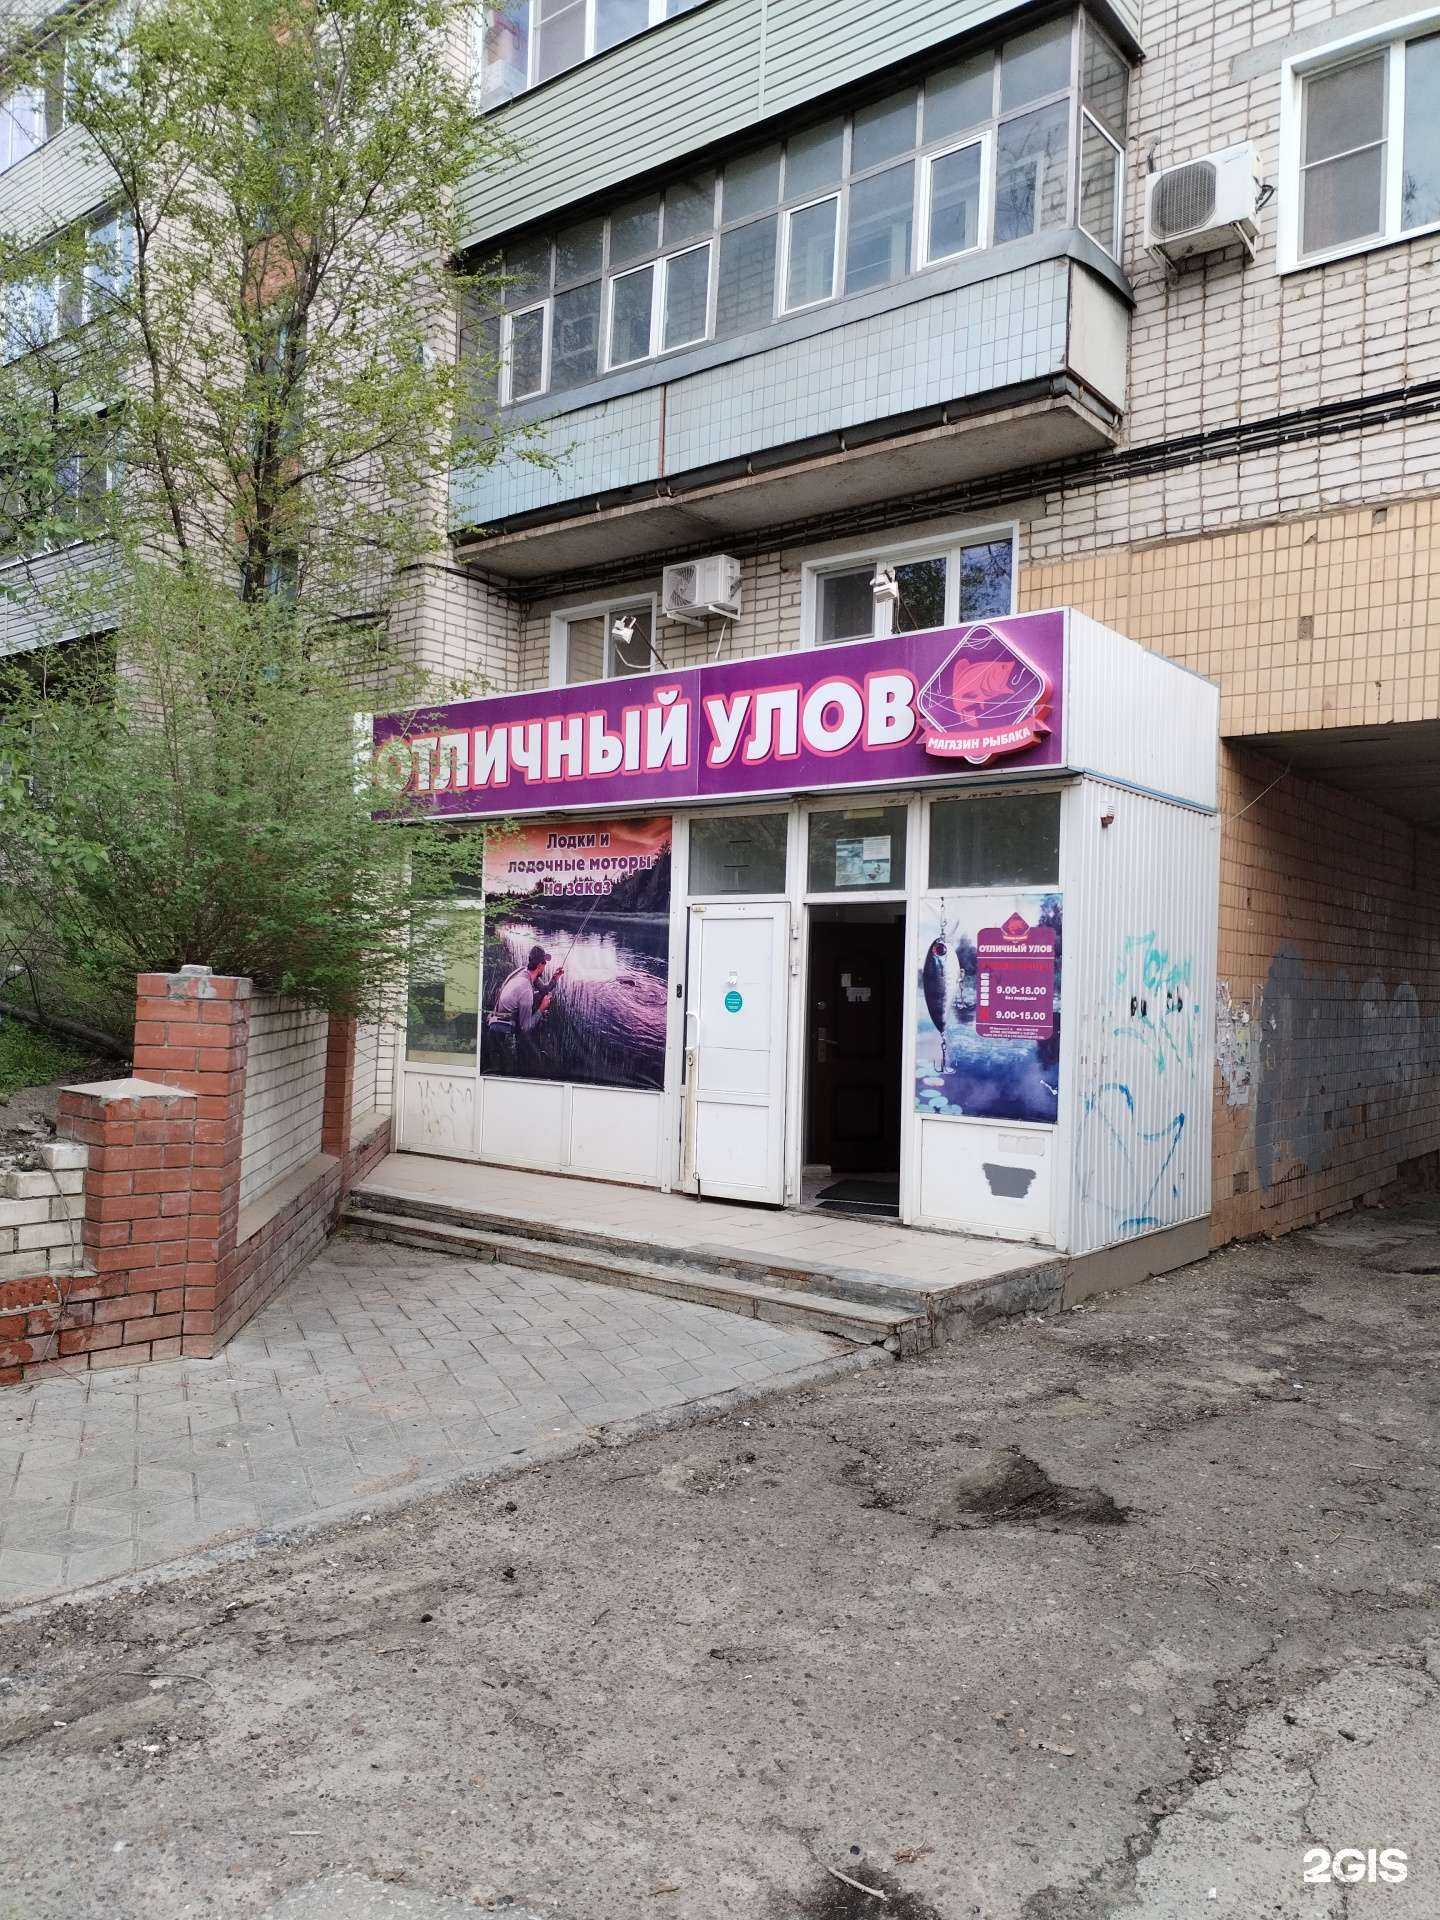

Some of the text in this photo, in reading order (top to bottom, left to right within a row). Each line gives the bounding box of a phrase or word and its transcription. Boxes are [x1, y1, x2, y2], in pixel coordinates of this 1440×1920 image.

[705, 673, 917, 766] УЛОВ
[927, 727, 1031, 751] МАГАЗИН РЫБАКА
[547, 832, 610, 849] Лодки и
[508, 855, 652, 875] лодочные моторы
[544, 880, 613, 896] на заказ
[978, 944, 1052, 953] ОТЛИЧНЫЙ УЛОВ
[996, 985, 1047, 995] 9.00-18.00
[995, 1010, 1046, 1020] 9.00-15.00
